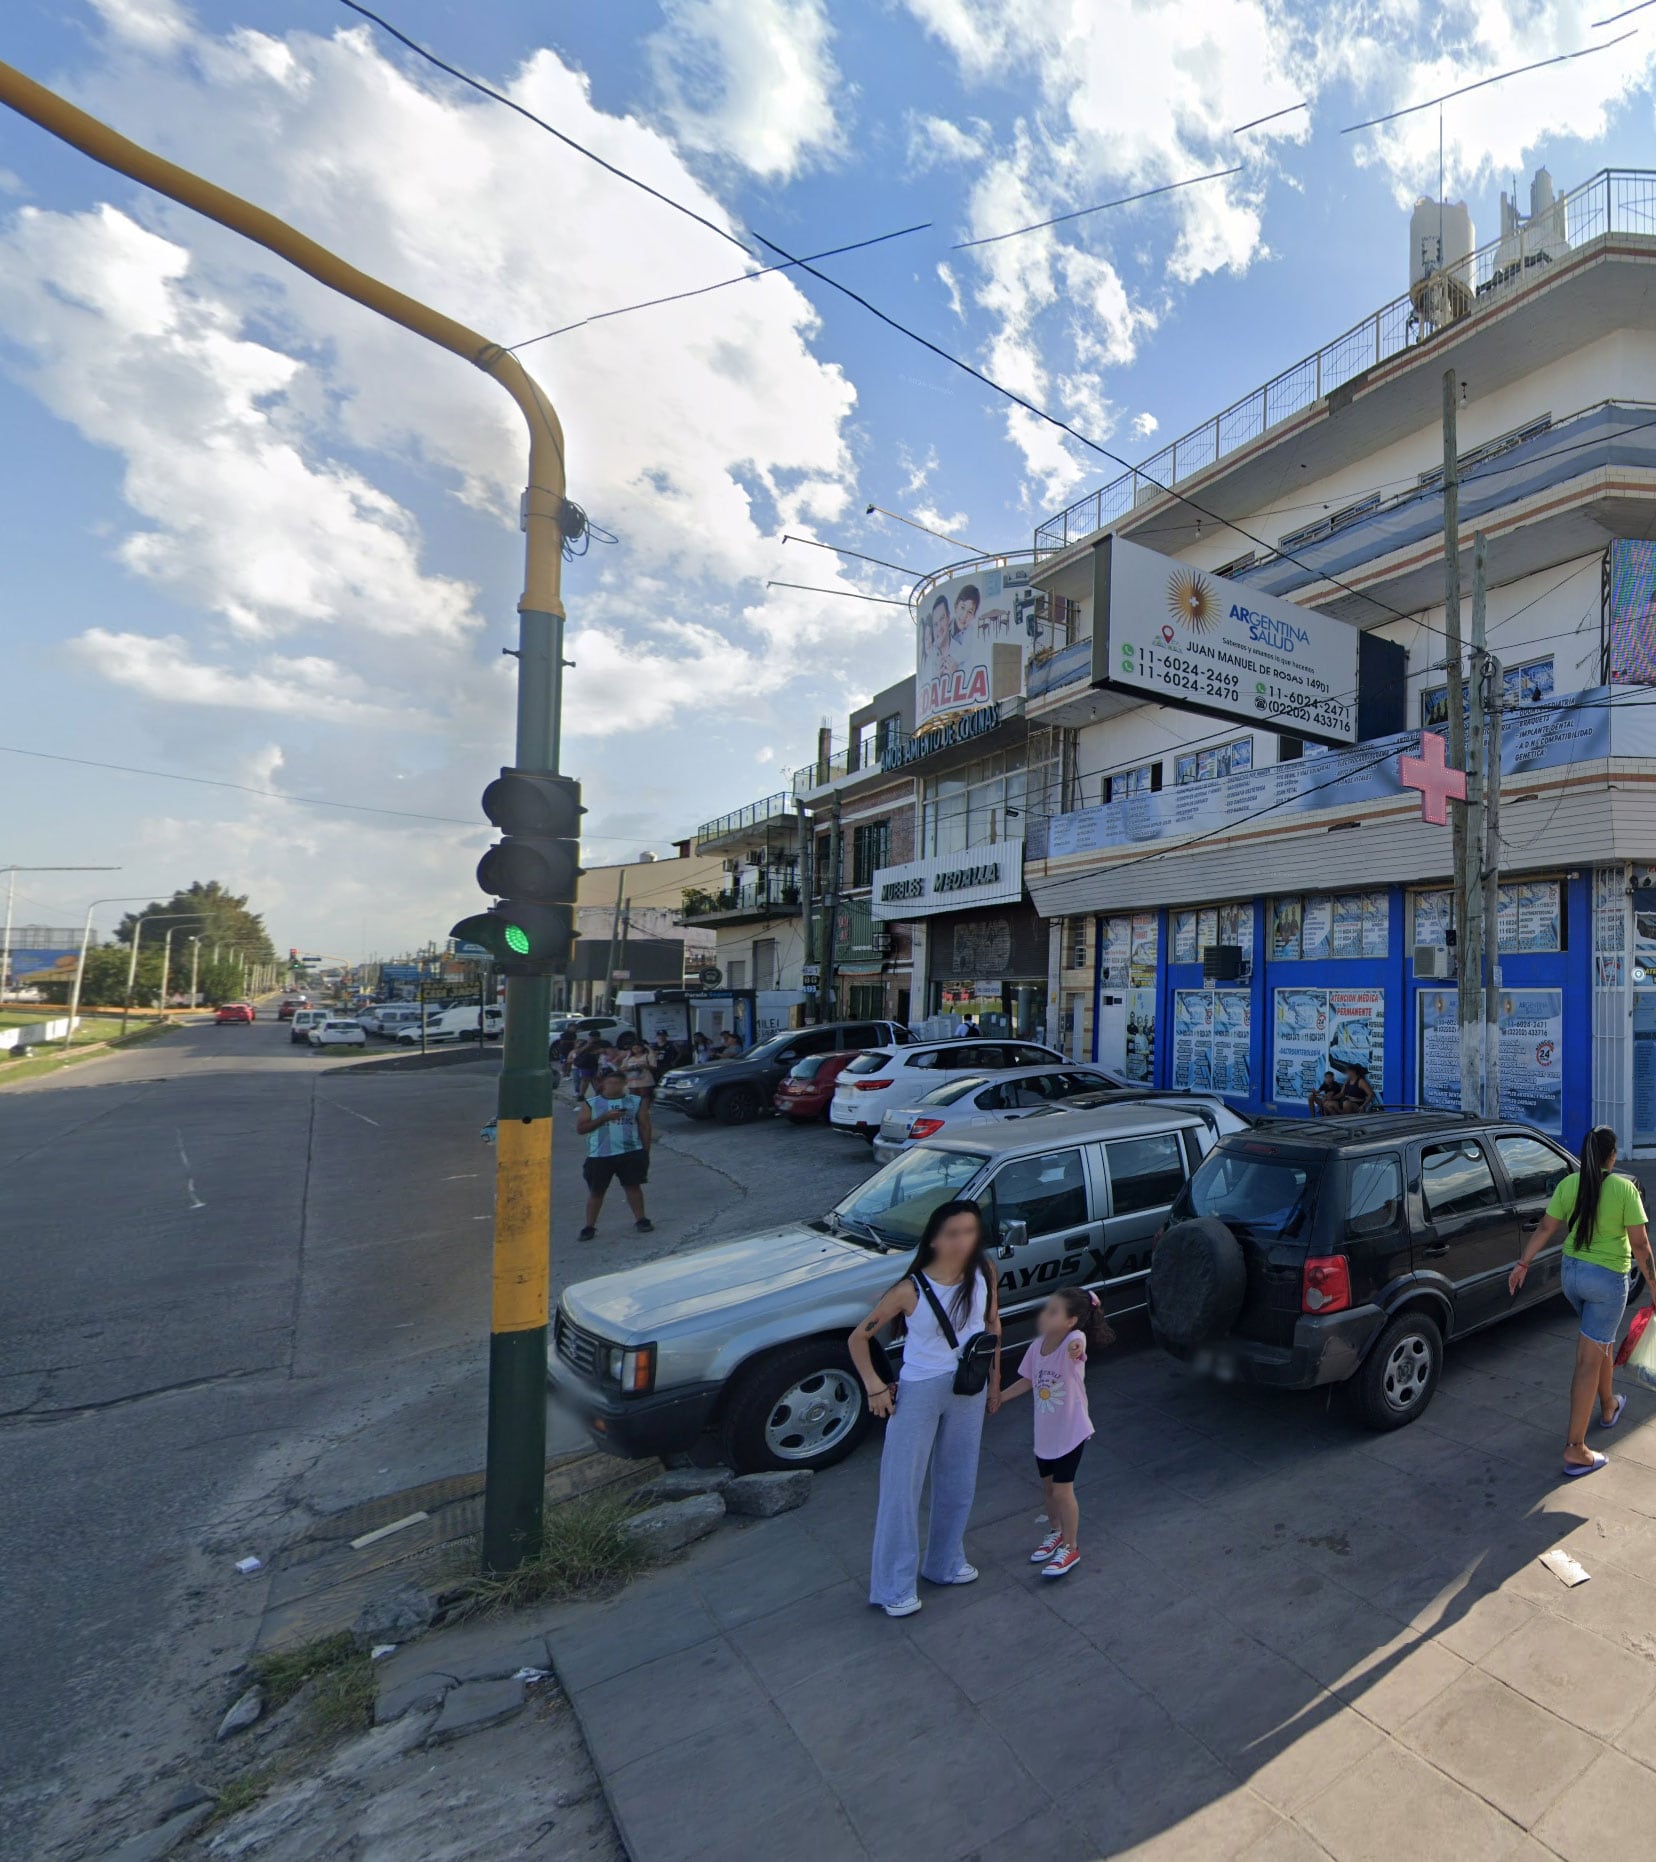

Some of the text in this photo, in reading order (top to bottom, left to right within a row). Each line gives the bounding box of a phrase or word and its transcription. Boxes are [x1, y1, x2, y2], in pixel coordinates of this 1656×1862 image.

[1229, 604, 1310, 645] ARGENTINA
[1249, 626, 1295, 653] SALUD
[1222, 637, 1248, 651] Sabemos
[1139, 647, 1239, 687] 11-6024-2469
[1139, 663, 1239, 702] 11-6024-2470
[1186, 641, 1214, 658] JUAN
[1217, 650, 1257, 673] MANUEL
[1259, 663, 1271, 675] DE
[1306, 677, 1330, 693] 14901
[957, 702, 1000, 740] COCINAS
[1268, 700, 1351, 732] (02202) 433716
[1269, 685, 1350, 719] 11-6024-2471
[881, 862, 1002, 902] MUEBLES MEDALLA
[1539, 1049, 1550, 1059] 24
[998, 1253, 1083, 1291] AYOS
